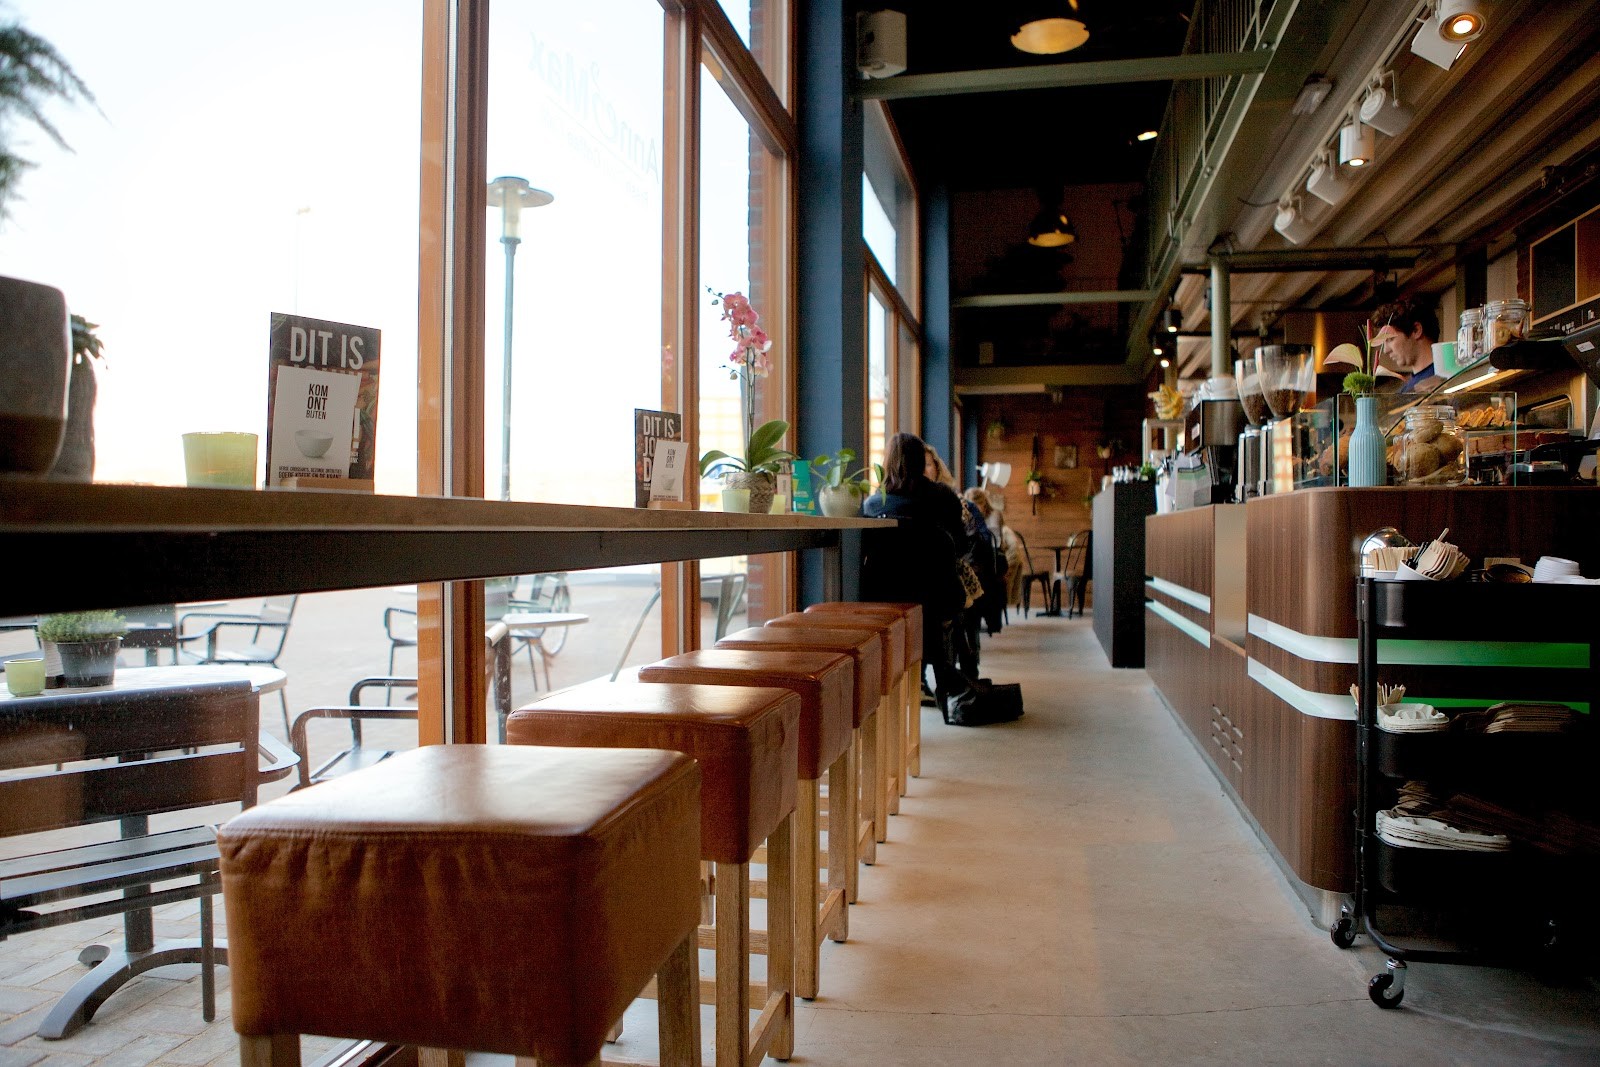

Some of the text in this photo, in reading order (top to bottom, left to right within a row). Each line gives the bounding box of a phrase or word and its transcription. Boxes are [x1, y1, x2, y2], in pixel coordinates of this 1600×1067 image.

[290, 326, 364, 370] DIT IS
[308, 383, 329, 397] KOM
[307, 396, 328, 411] ONT
[643, 415, 675, 439] DIT IS
